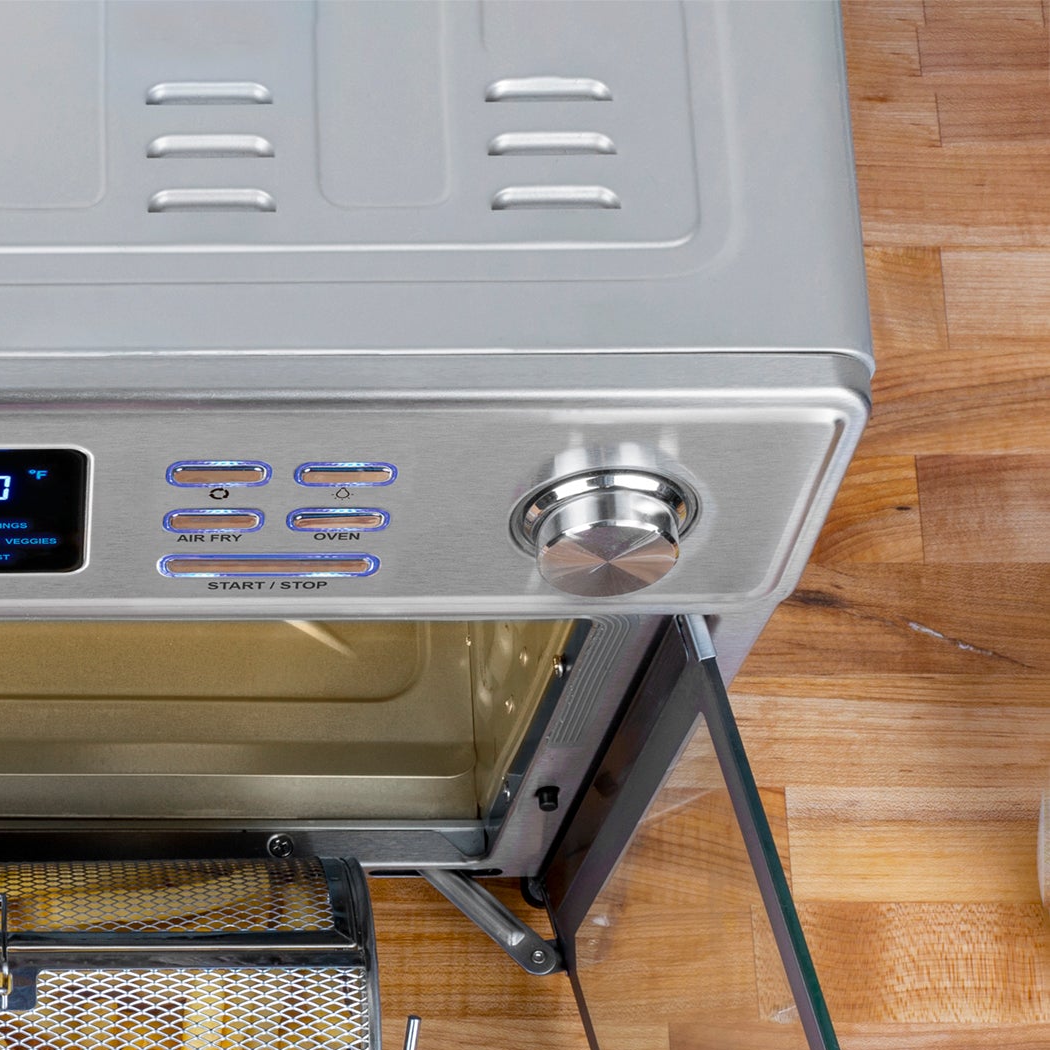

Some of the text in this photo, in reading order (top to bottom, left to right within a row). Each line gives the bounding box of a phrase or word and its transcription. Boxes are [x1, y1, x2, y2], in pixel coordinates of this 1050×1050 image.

[5, 537, 57, 545] VEGGIES
[176, 534, 243, 543] AIR FRY
[313, 532, 361, 541] OVEN
[207, 581, 266, 591] START
[280, 580, 328, 590] STOP
